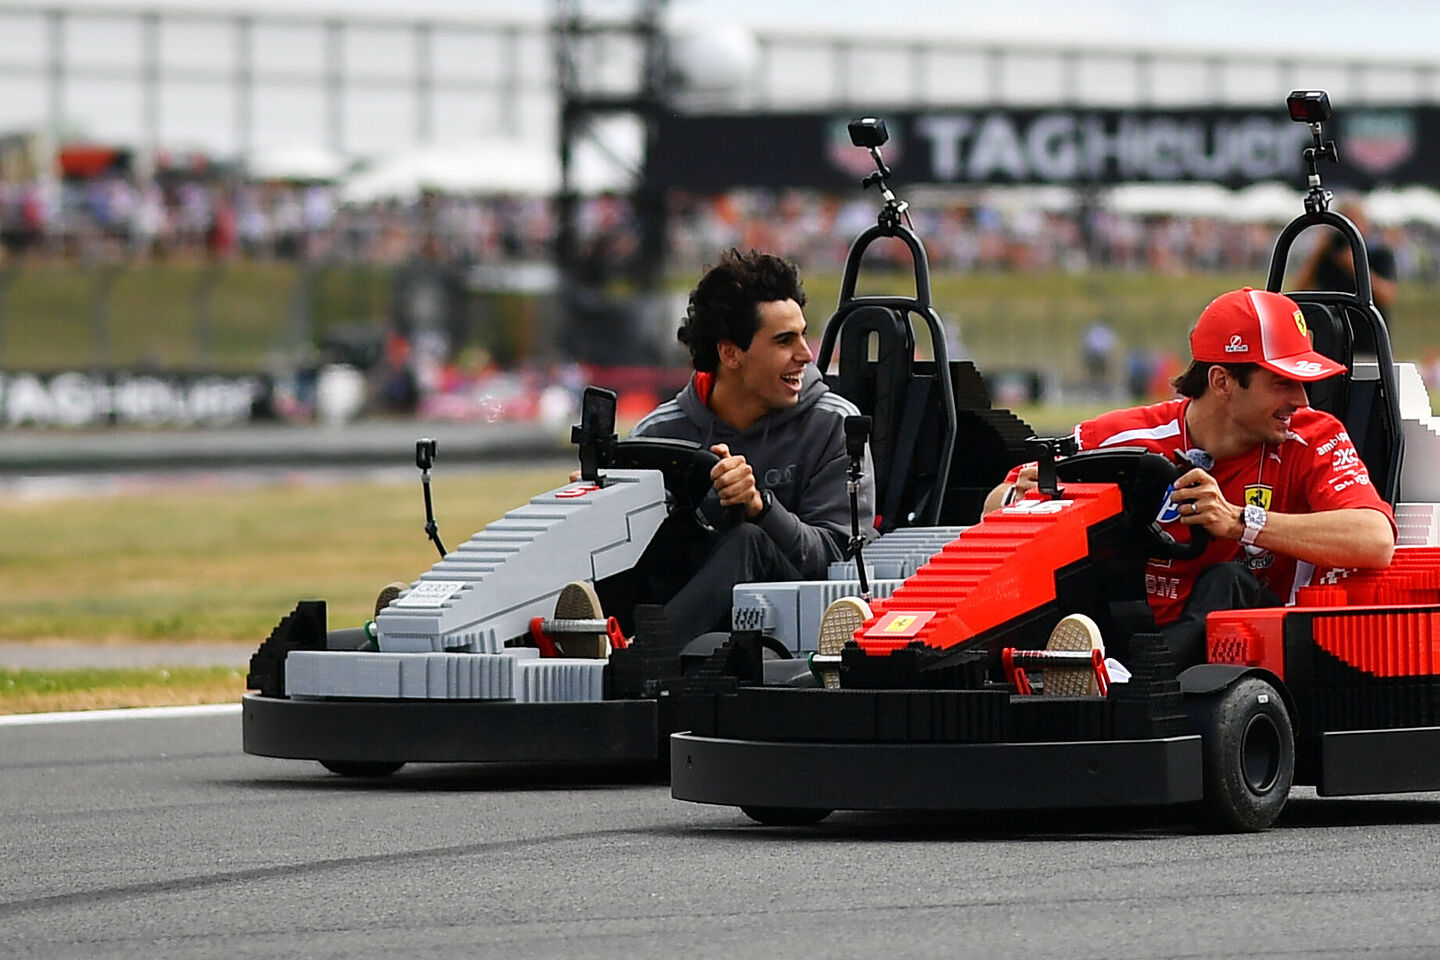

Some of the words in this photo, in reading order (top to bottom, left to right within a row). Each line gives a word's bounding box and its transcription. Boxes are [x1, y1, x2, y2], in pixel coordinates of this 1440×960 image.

[1293, 360, 1323, 373] 16
[1002, 500, 1074, 514] 16
[1145, 573, 1180, 600] BM
